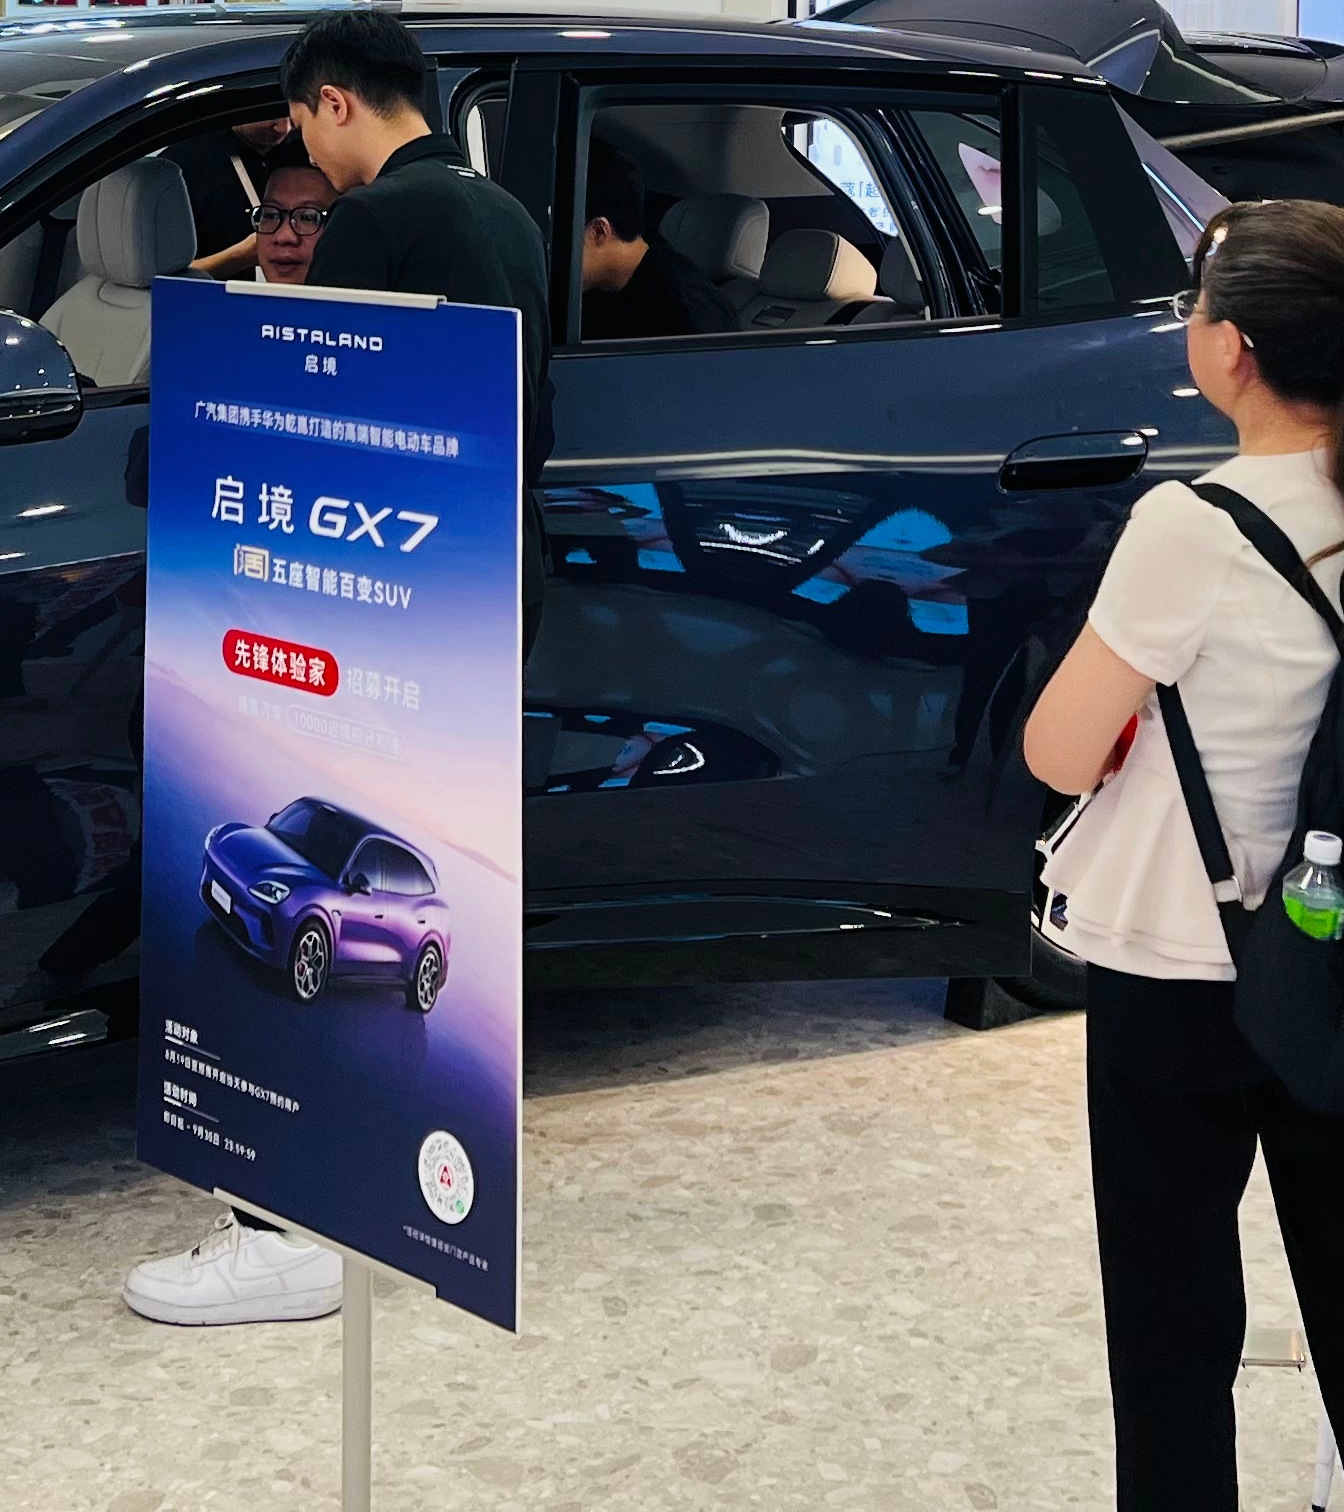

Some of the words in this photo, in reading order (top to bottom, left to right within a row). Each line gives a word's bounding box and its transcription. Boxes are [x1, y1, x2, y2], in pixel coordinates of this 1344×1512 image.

[261, 324, 384, 352] AISTALAND
[304, 354, 338, 376] 启境
[211, 475, 294, 535] 启境
[308, 495, 440, 553] GX7
[234, 639, 326, 687] 先锋体验家
